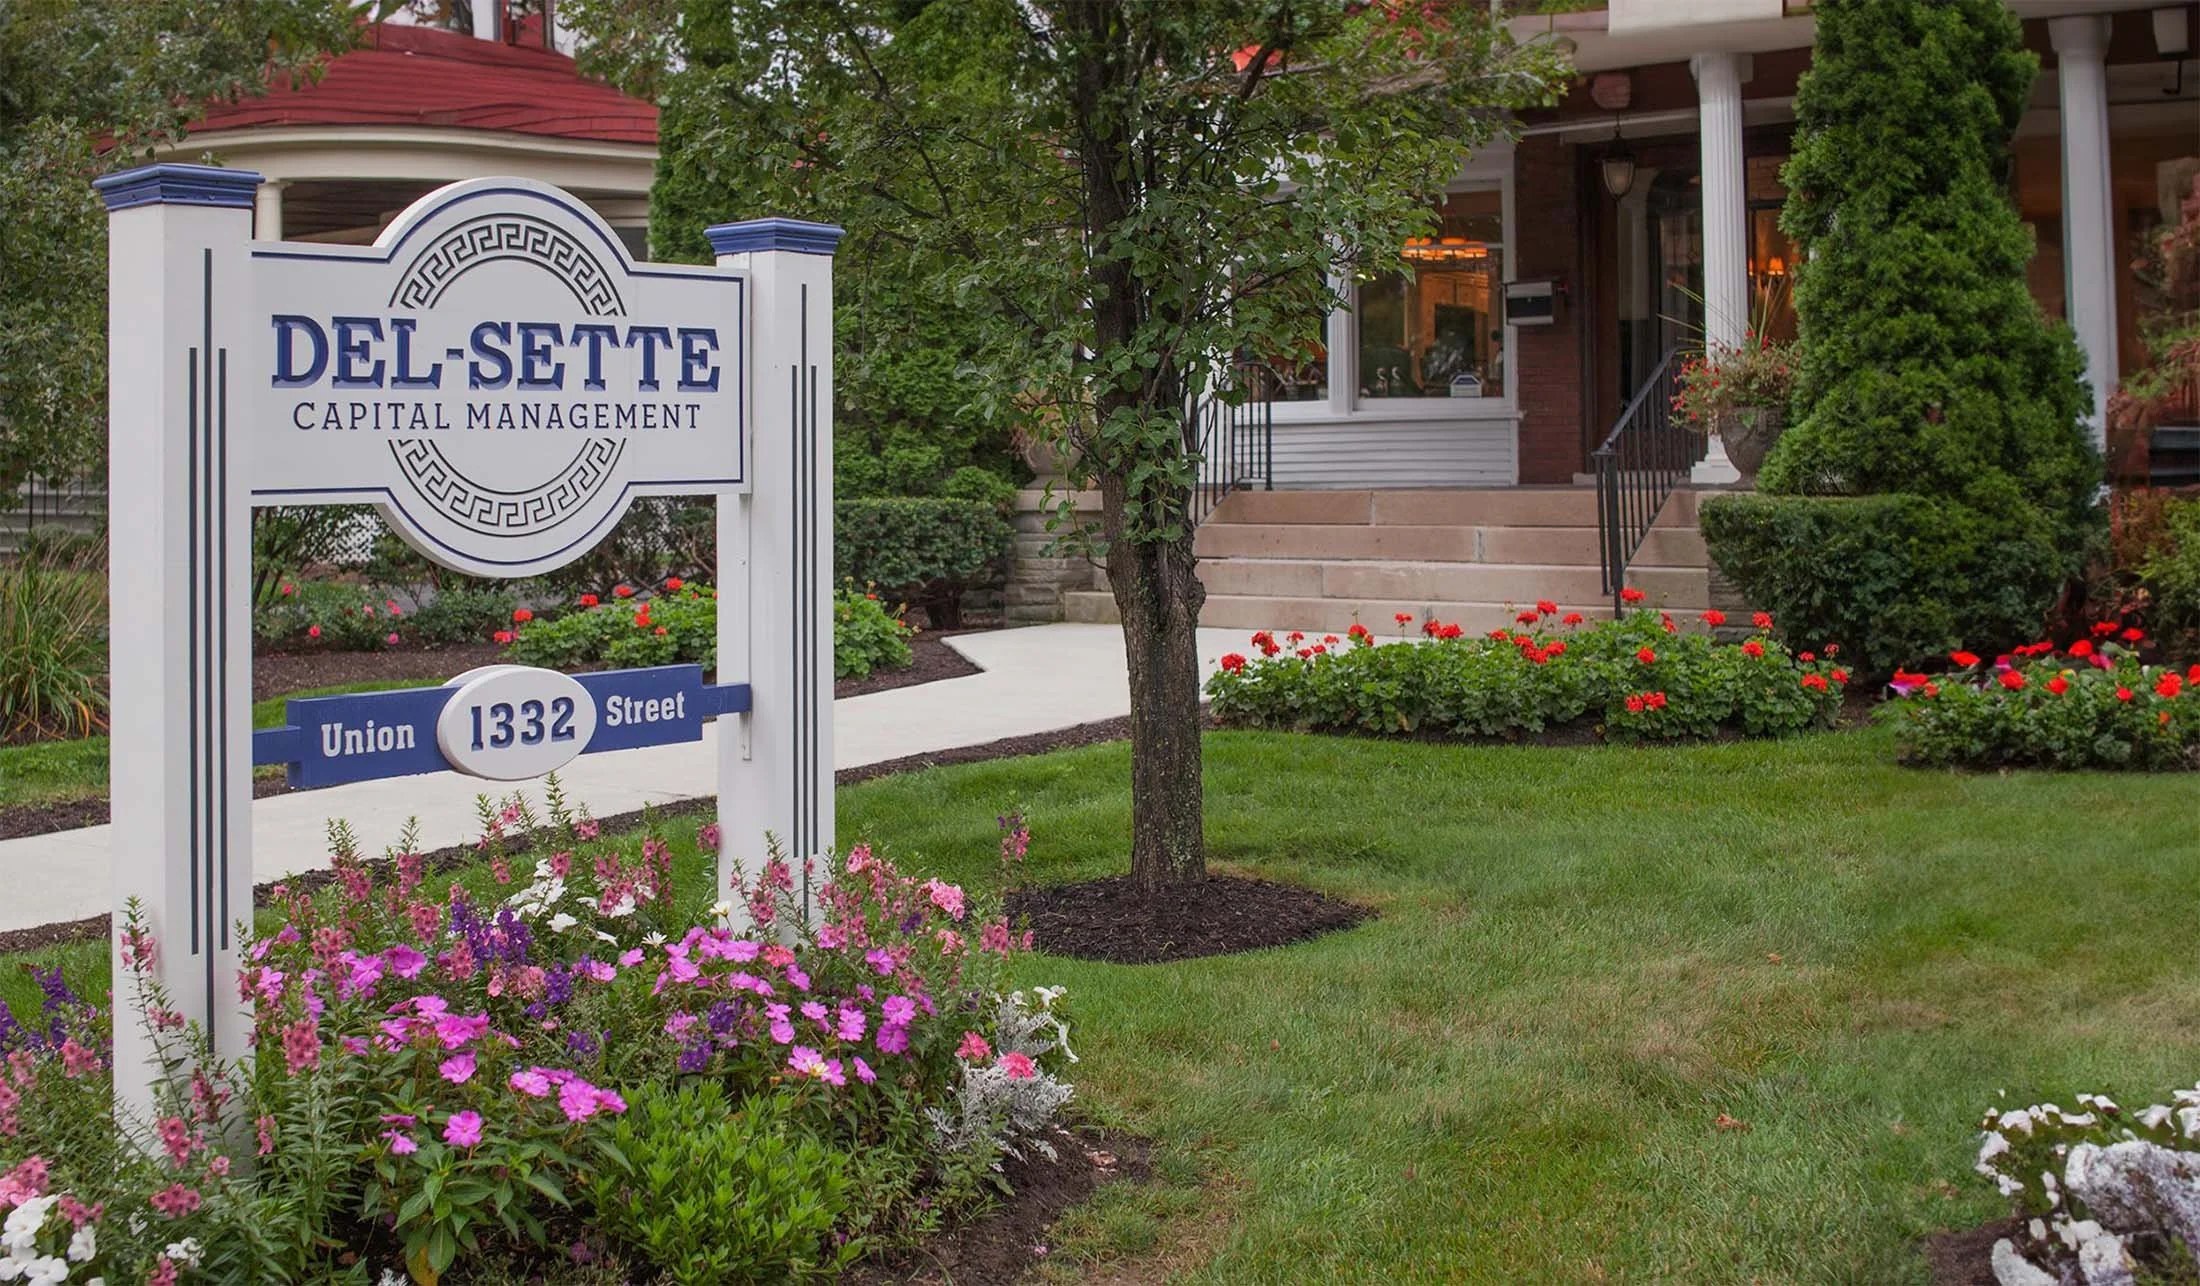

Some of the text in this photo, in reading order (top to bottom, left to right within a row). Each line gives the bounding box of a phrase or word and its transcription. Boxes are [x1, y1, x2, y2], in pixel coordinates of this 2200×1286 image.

[272, 315, 720, 393] DEL-SETTE
[293, 402, 700, 430] CAPITAL MANAGEMENT
[321, 692, 685, 758] Union 1332 Street
